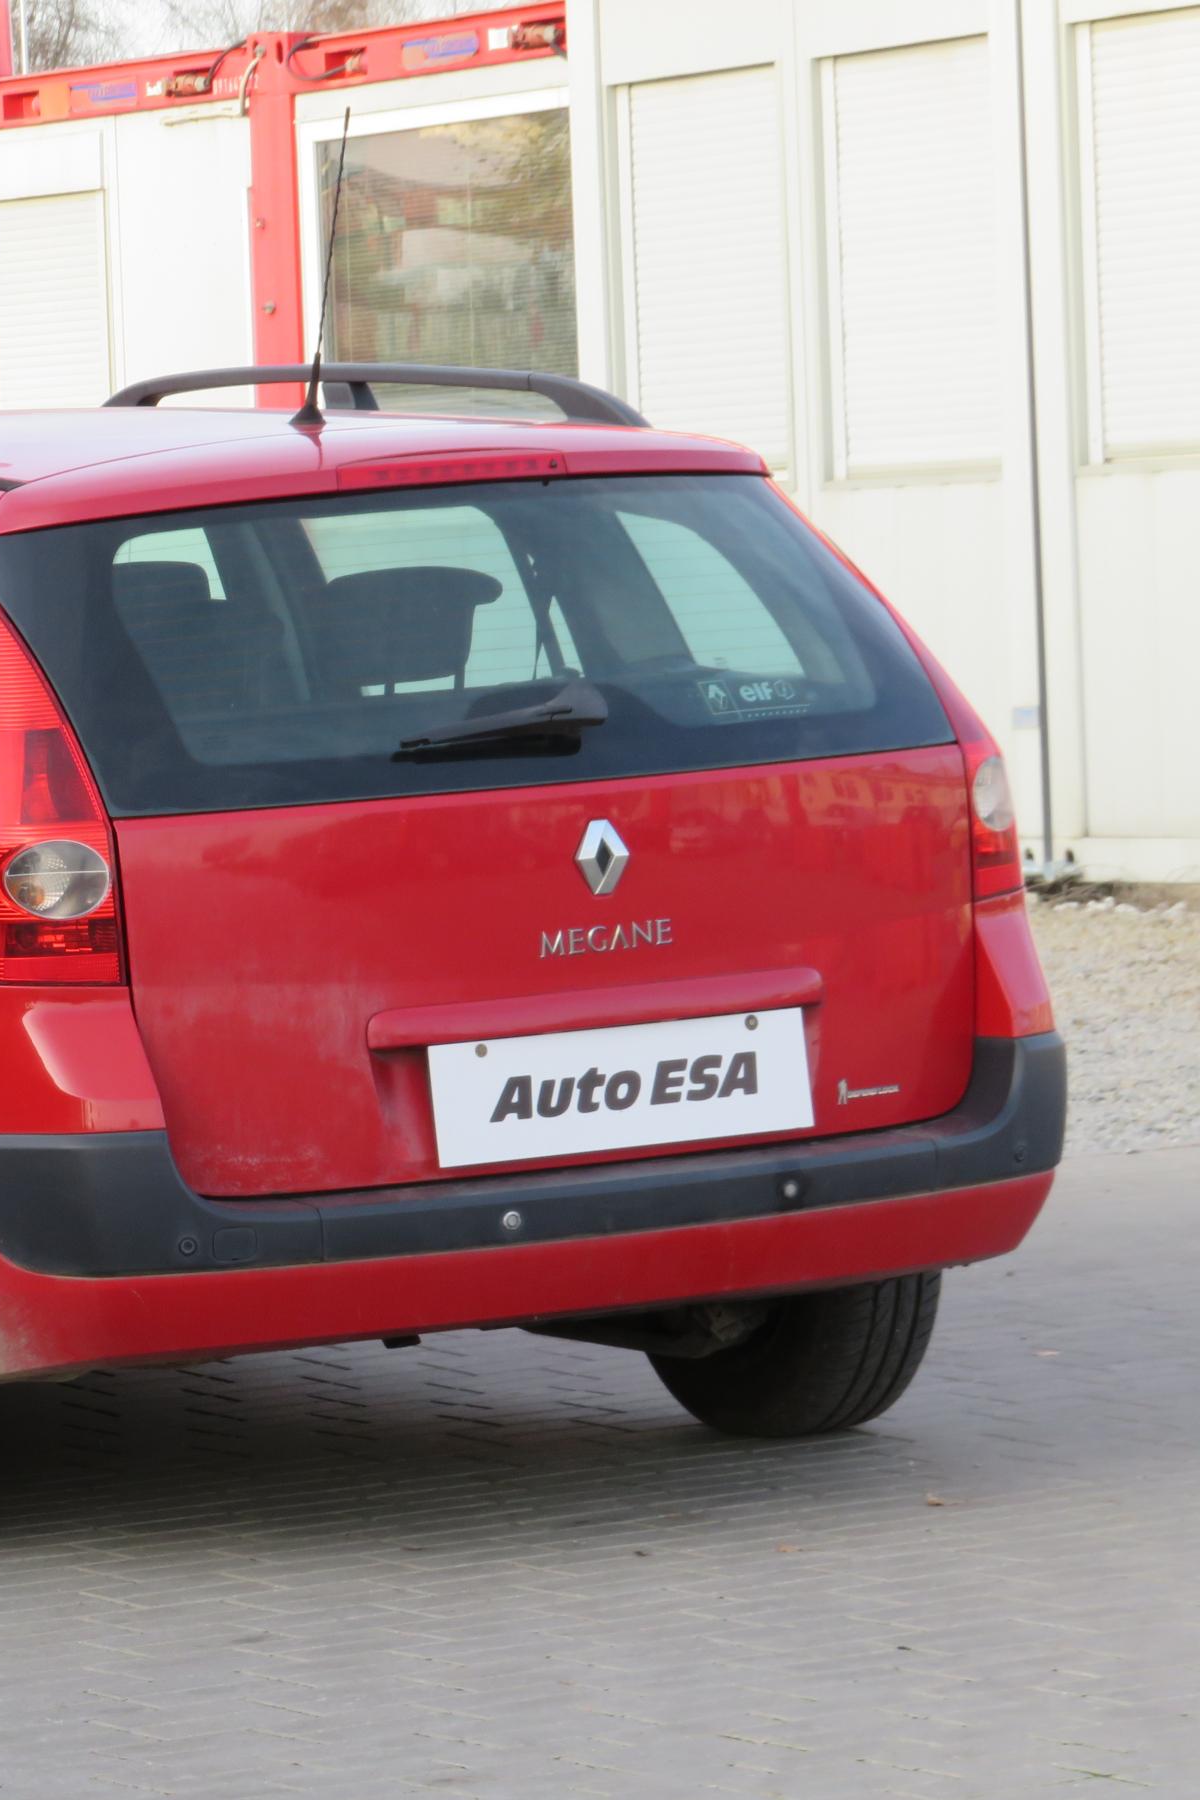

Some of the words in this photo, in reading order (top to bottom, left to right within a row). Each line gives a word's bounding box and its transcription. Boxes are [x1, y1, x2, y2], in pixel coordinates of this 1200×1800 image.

[739, 682, 773, 701] elf
[539, 918, 673, 959] MEGANE
[490, 1067, 642, 1123] Auto
[650, 1051, 758, 1105] ESA
